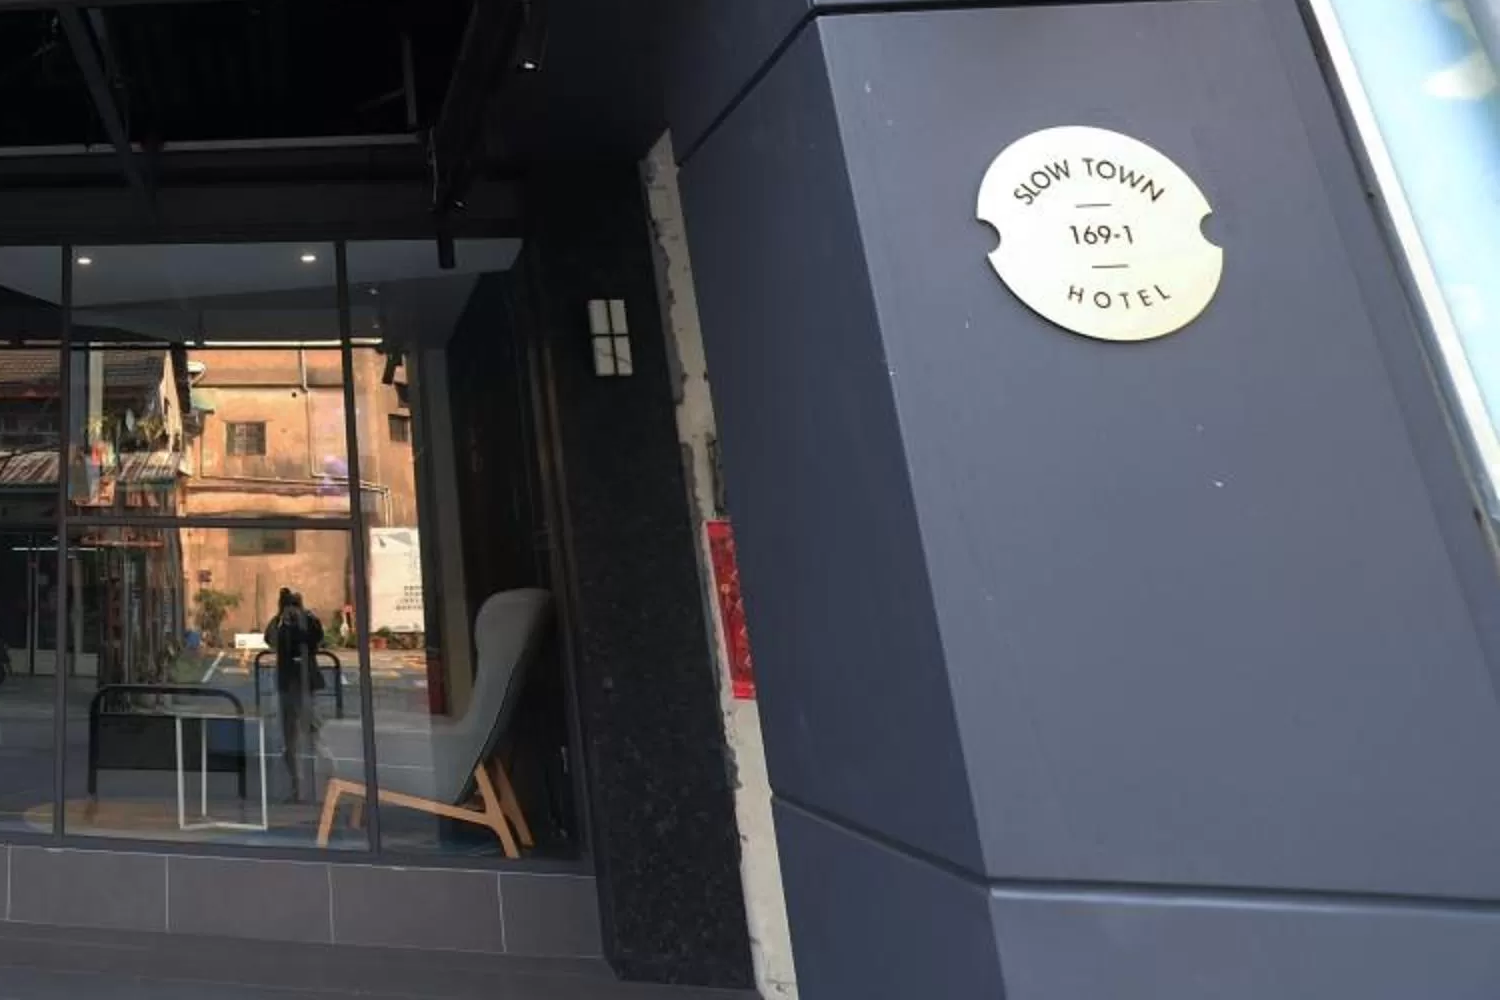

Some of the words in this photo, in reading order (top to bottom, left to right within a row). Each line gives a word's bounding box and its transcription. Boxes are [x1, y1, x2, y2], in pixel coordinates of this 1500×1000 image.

[1014, 159, 1071, 205] SLOW
[1082, 158, 1165, 202] TOWN
[1069, 225, 1134, 245] 169-1
[1068, 285, 1170, 309] HOTEL
